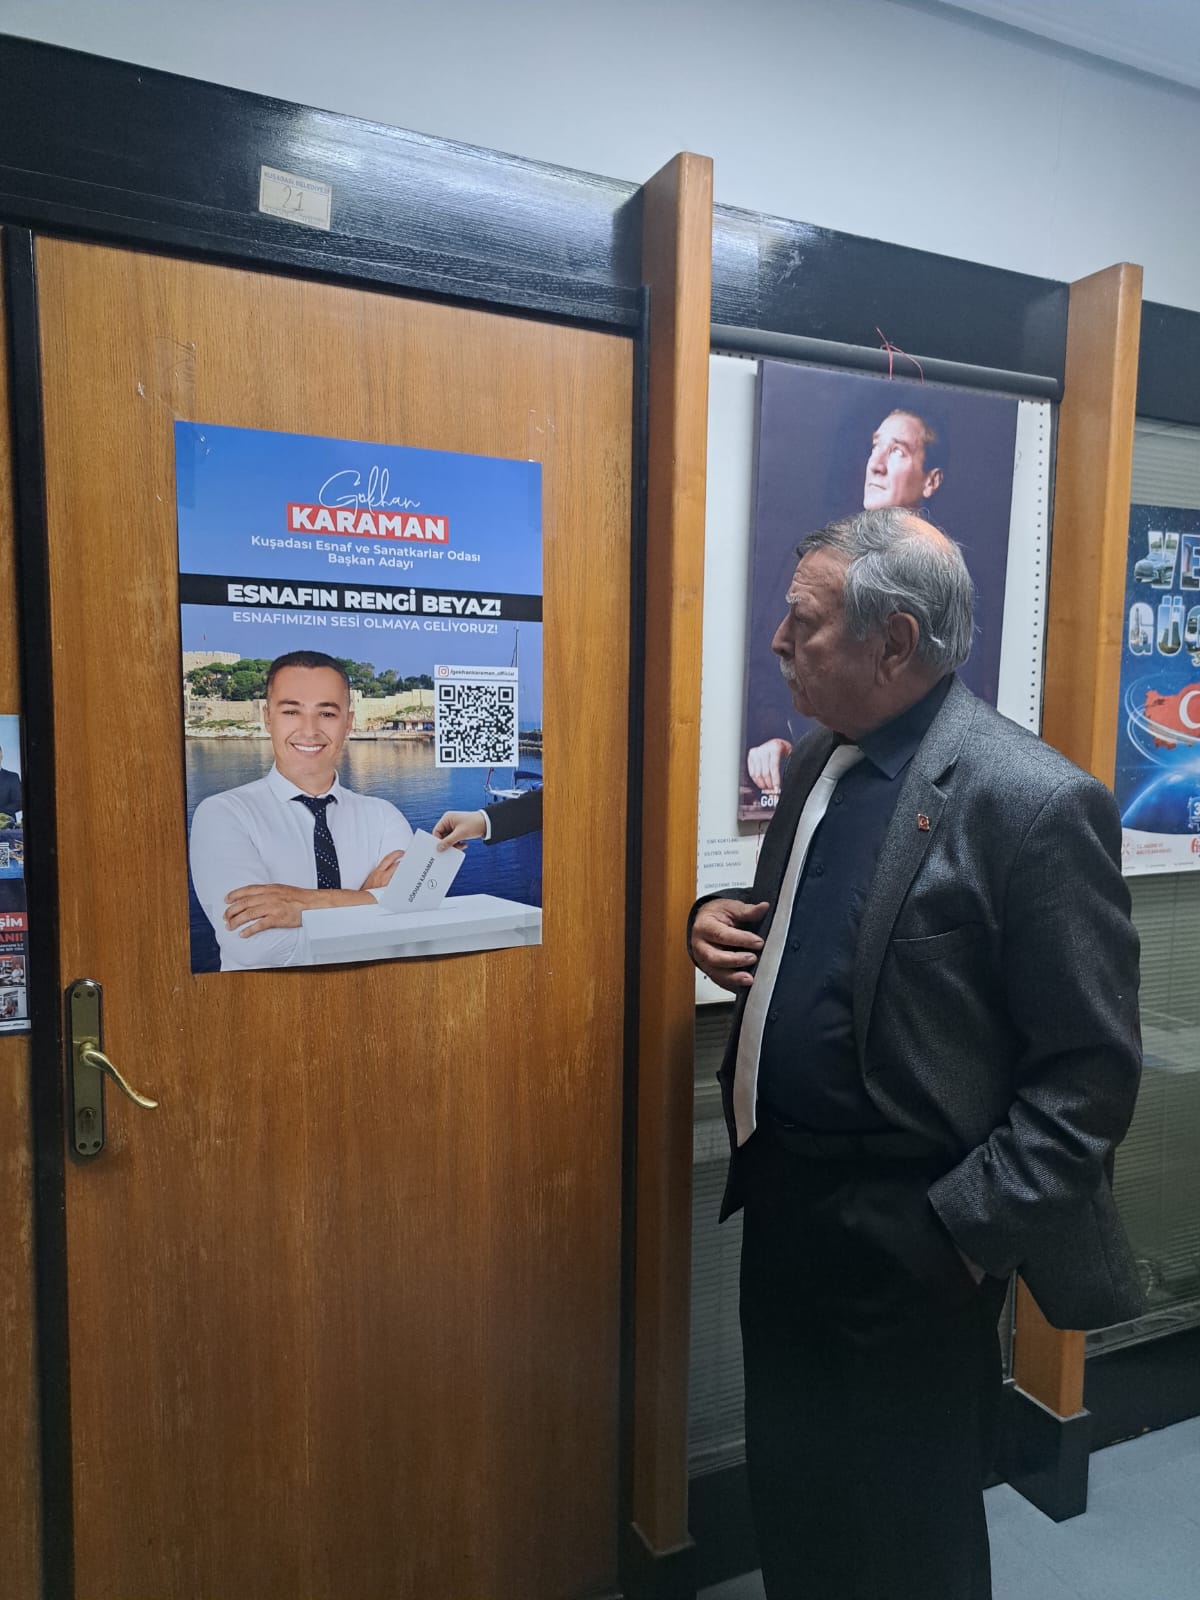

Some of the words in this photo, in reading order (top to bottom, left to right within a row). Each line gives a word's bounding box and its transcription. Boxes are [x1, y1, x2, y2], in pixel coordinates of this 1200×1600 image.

[291, 506, 445, 540] KARAMAN
[251, 535, 312, 550] Kuşadası
[316, 540, 352, 553] Esnaf
[355, 544, 370, 554] ve
[373, 543, 444, 560] Sanatkarlar
[447, 550, 481, 562] Odası
[328, 553, 375, 567] Başkan
[378, 557, 414, 570] Adayı
[227, 583, 338, 608] ESNAFIN
[344, 589, 417, 612] RENGİ
[422, 596, 502, 616] BEYAZ!
[233, 611, 327, 626] ESNAFIMIZIN
[331, 616, 360, 628] SESİ
[364, 617, 420, 631] OLMAYA
[423, 619, 499, 634] GELİYORUZ!
